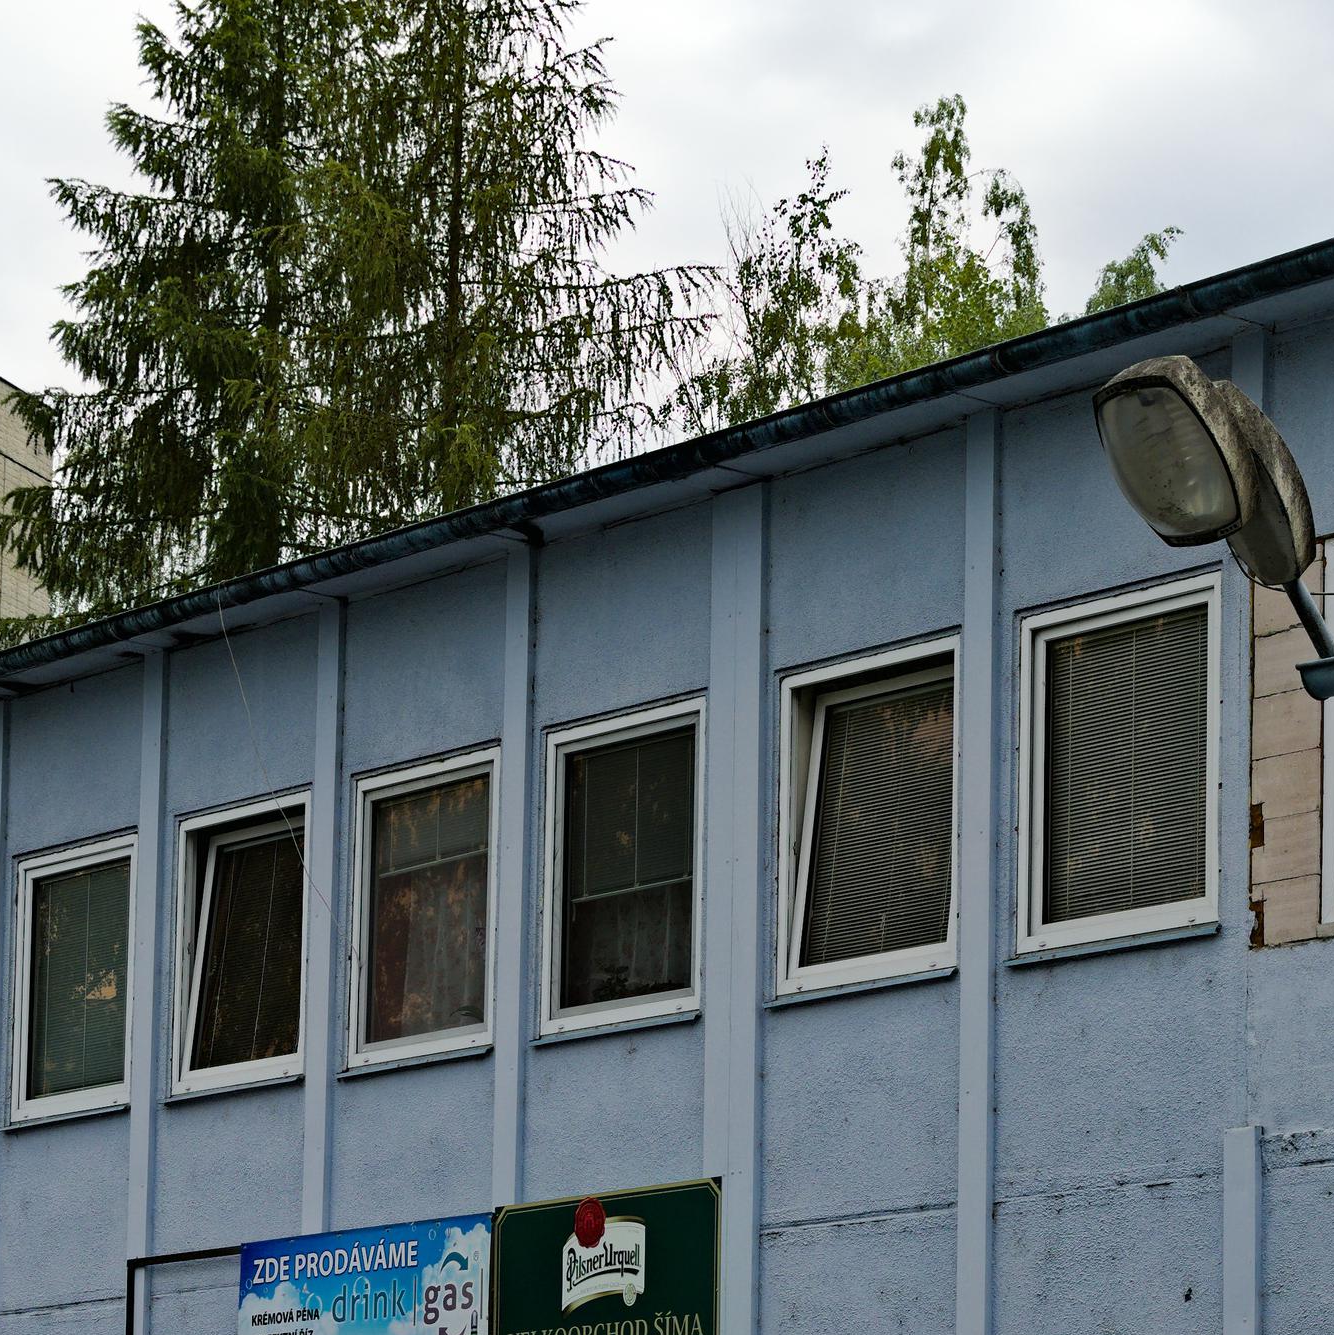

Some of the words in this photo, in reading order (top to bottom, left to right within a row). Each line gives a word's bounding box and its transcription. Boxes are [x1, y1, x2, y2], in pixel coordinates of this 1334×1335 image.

[252, 1257, 291, 1285] ZDE
[294, 1238, 418, 1280] PRODÁVÁME
[566, 1247, 604, 1293] Pilsner
[603, 1241, 640, 1277] Urquell
[251, 1308, 294, 1327] KRÉMOVÁ
[332, 1279, 406, 1323] drink
[423, 1281, 474, 1325] gas
